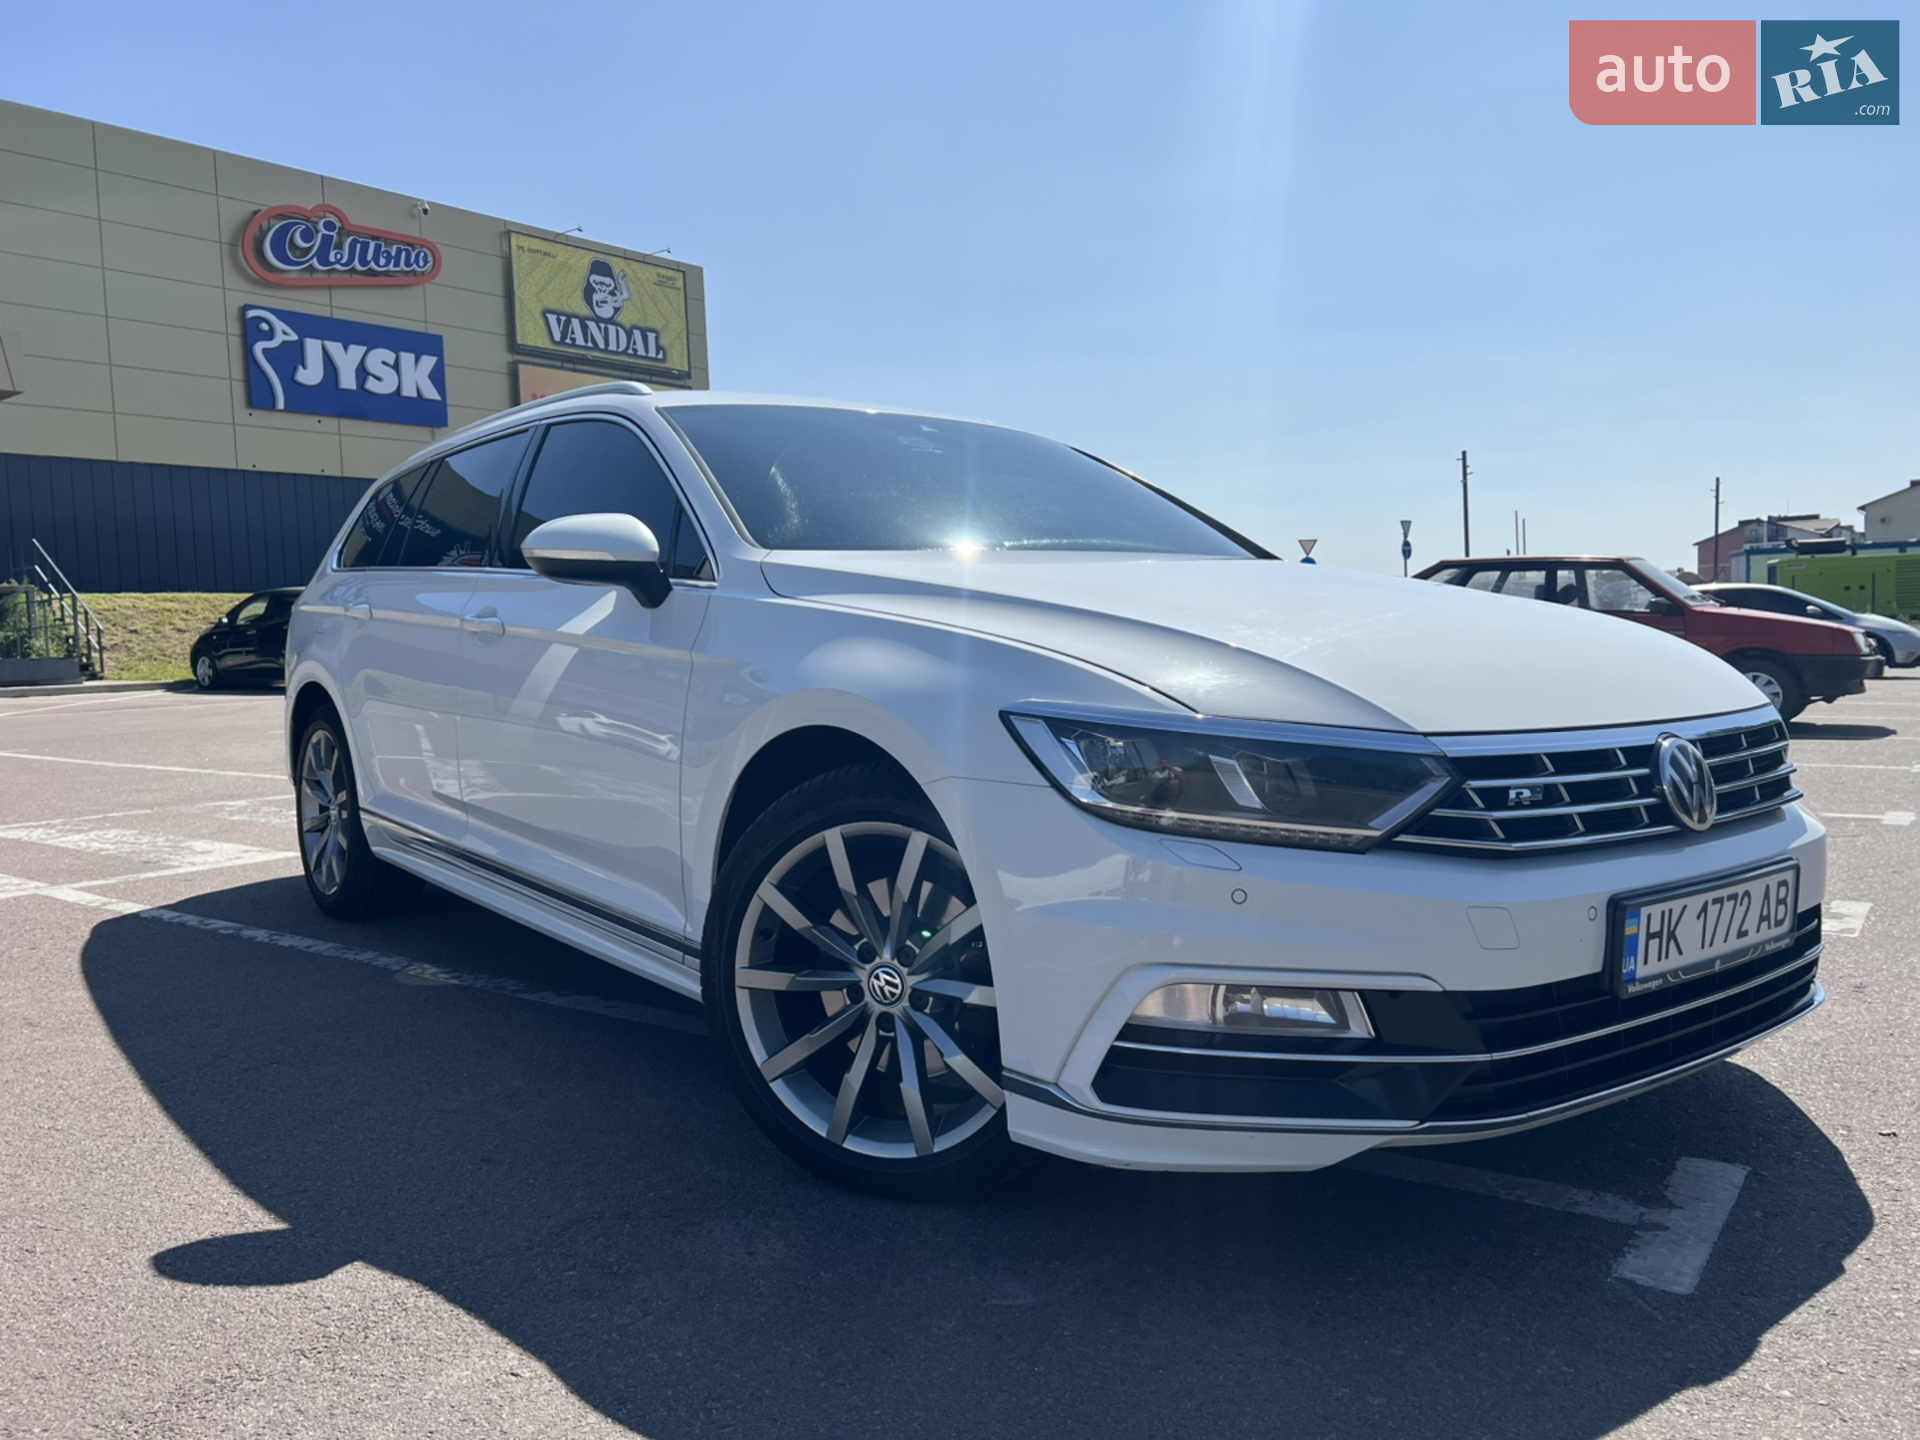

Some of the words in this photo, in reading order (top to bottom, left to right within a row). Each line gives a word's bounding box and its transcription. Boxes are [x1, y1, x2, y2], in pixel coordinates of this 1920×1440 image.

[263, 219, 433, 272] Сільпо
[545, 312, 665, 360] VANDAL
[293, 337, 442, 402] JYSK
[1643, 904, 1688, 967] HK
[1696, 889, 1752, 950] 1772
[1756, 879, 1790, 934] AB
[1622, 956, 1635, 974] UA
